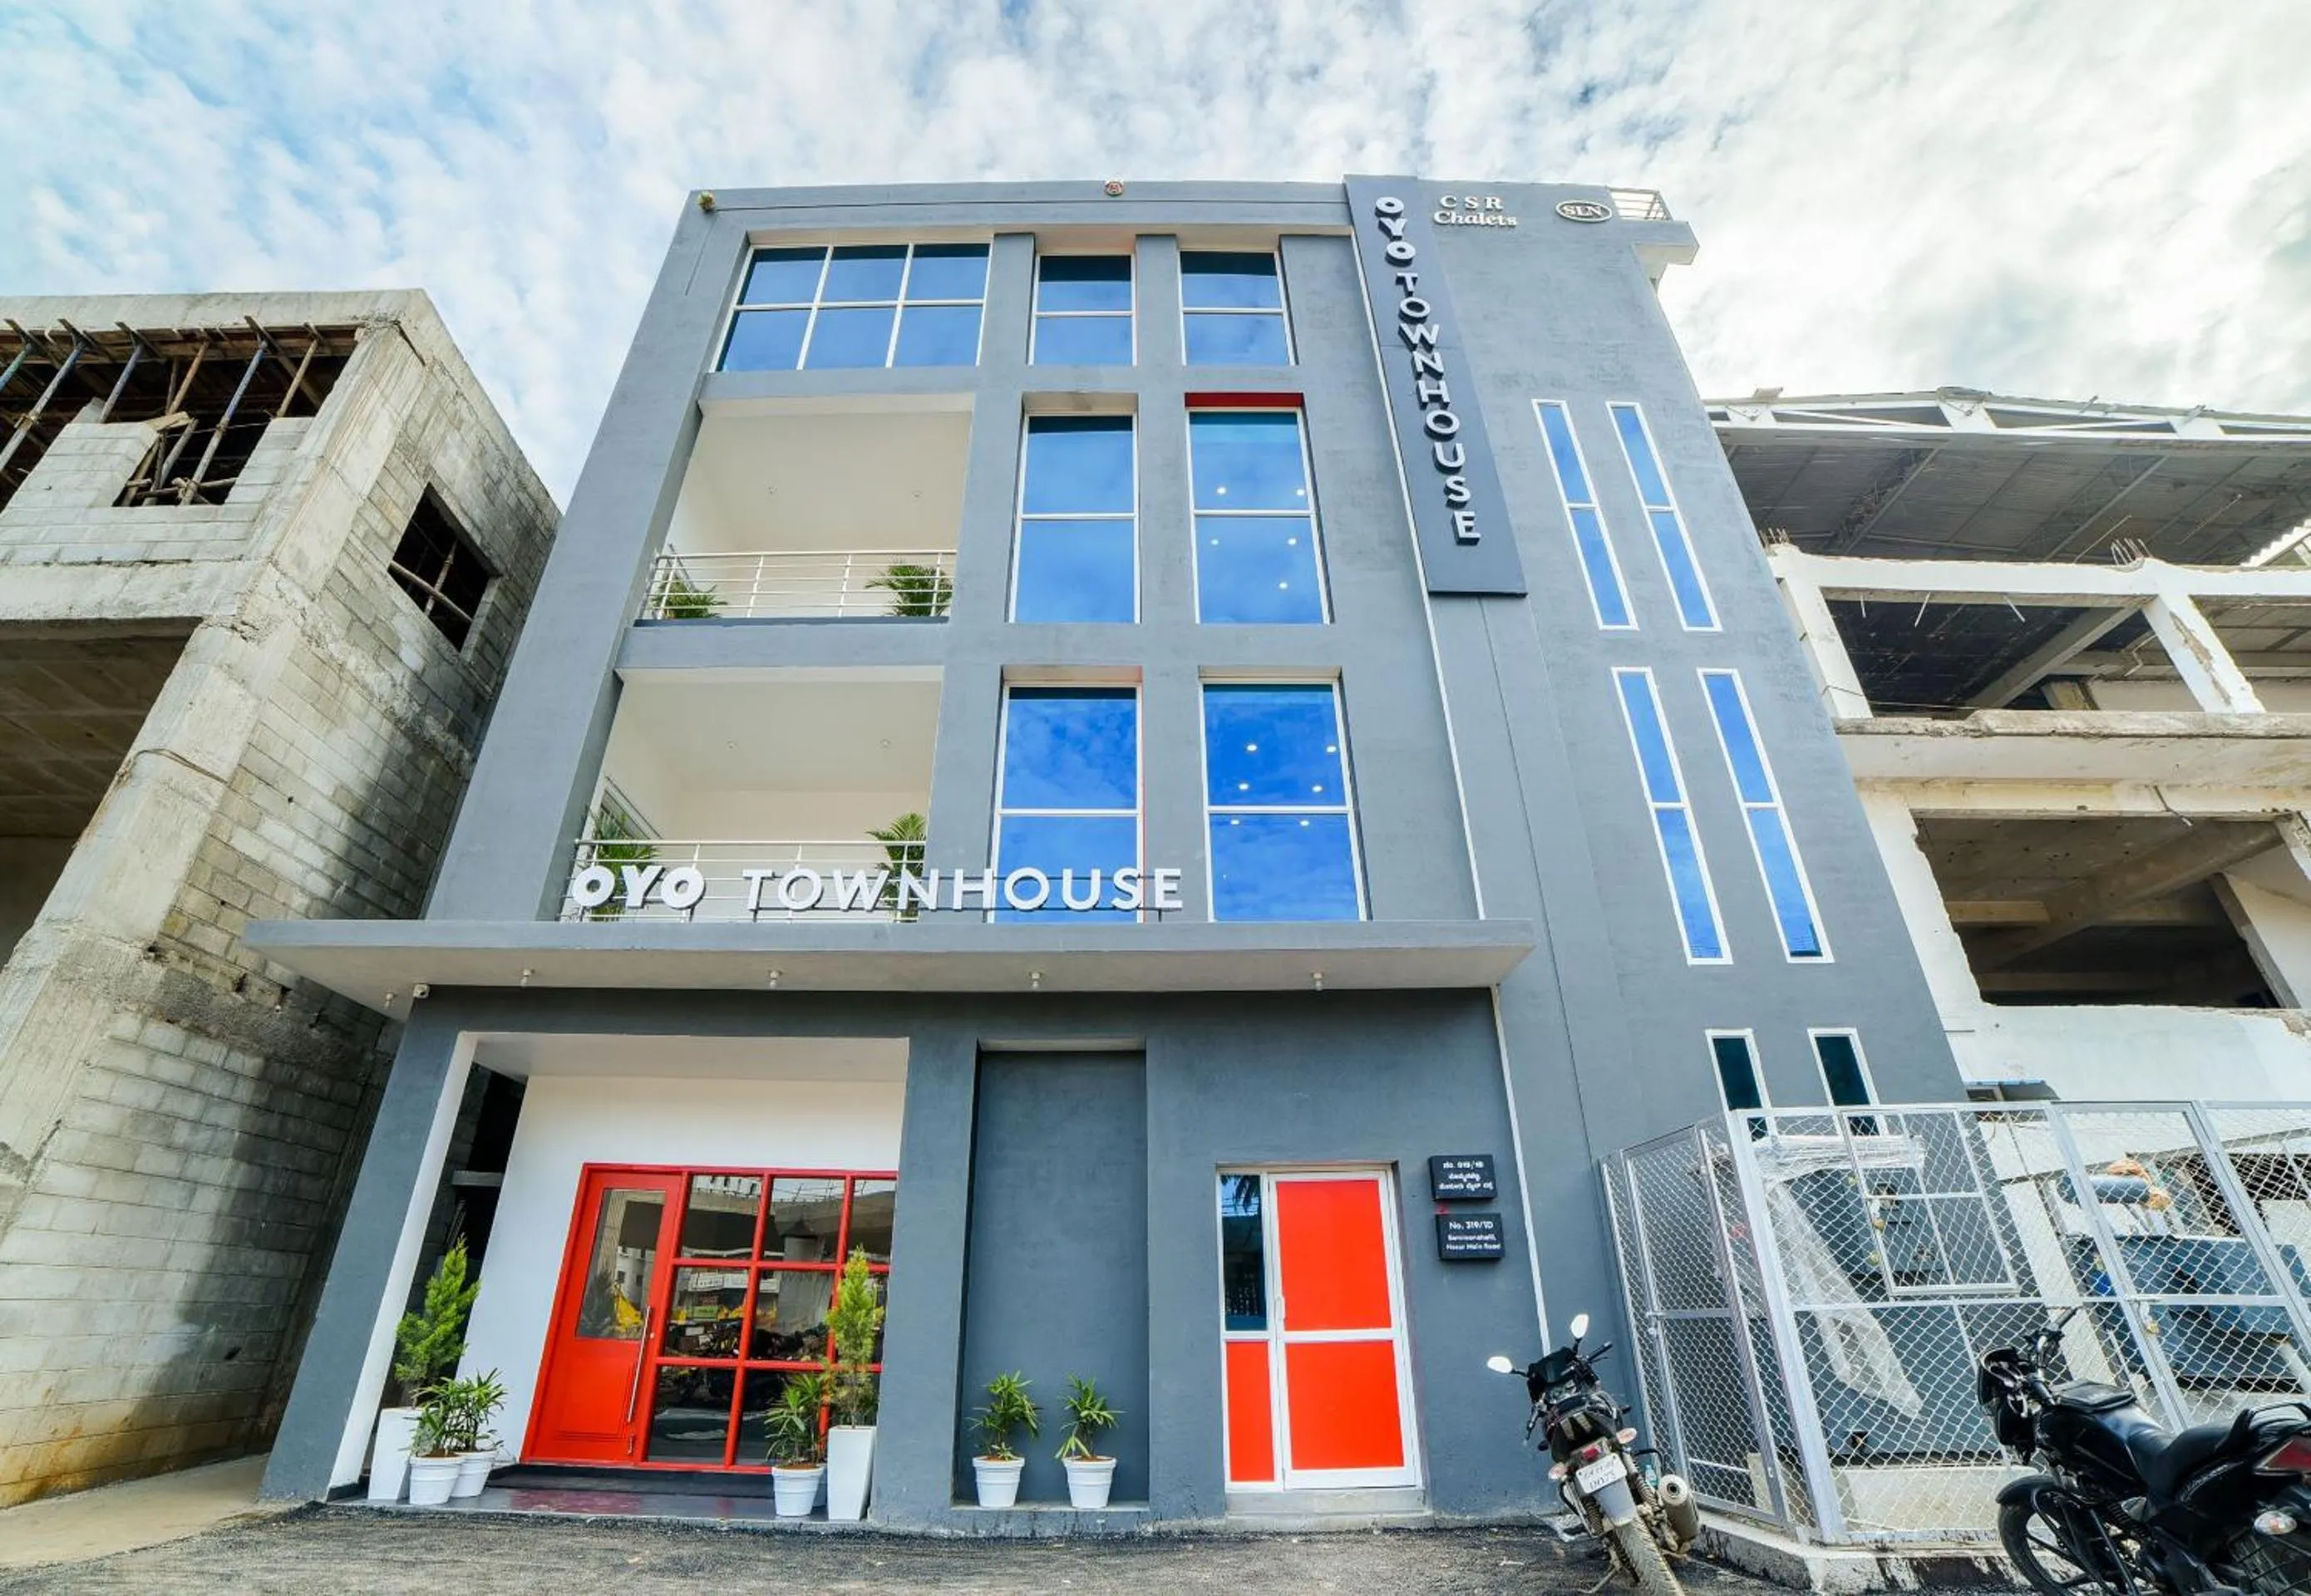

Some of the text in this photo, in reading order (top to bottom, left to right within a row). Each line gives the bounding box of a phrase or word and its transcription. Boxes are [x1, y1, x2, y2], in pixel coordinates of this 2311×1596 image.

[1434, 210, 1517, 227] Chalets
[1375, 196, 1481, 546] OYO TOWNHOUSE
[571, 864, 1183, 911] OYO TOWNHOUSE
